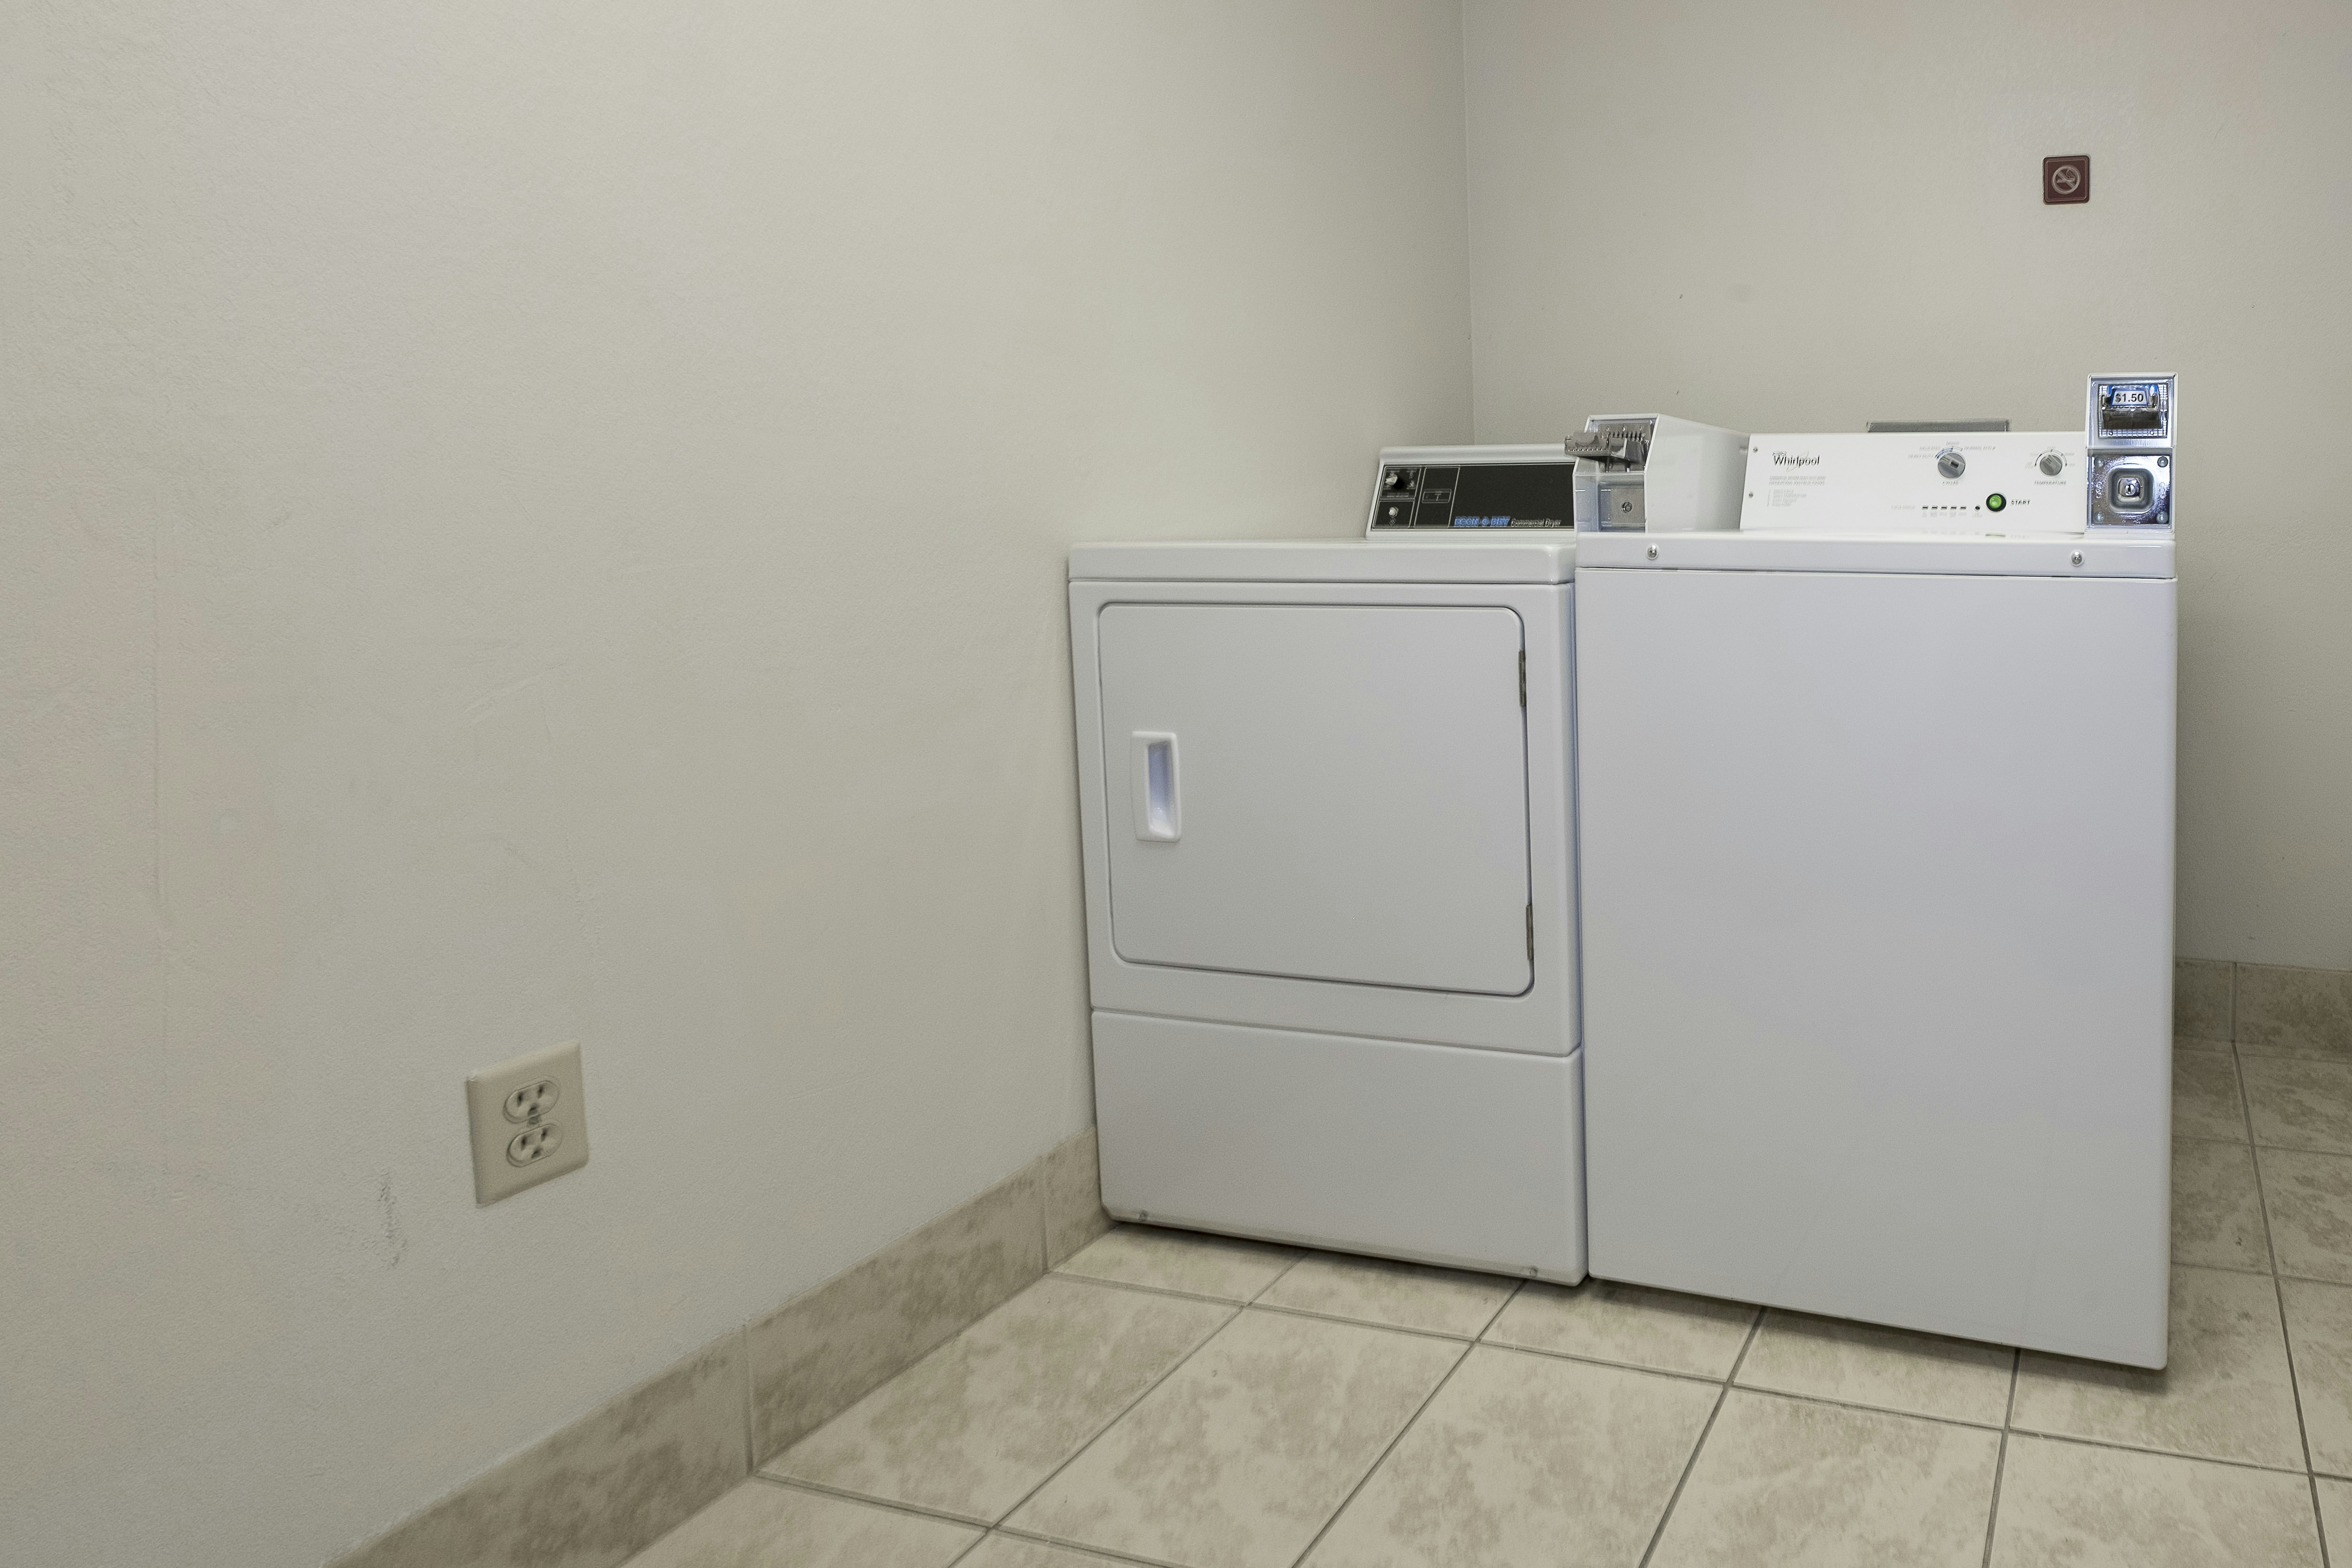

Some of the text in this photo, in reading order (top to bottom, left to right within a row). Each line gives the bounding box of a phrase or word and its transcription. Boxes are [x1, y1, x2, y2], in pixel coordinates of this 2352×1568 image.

[2115, 392, 2144, 404] $1.50
[1772, 454, 1820, 469] Whirlpool
[1511, 518, 1543, 527] Commercial
[1545, 518, 1561, 528] Dryer
